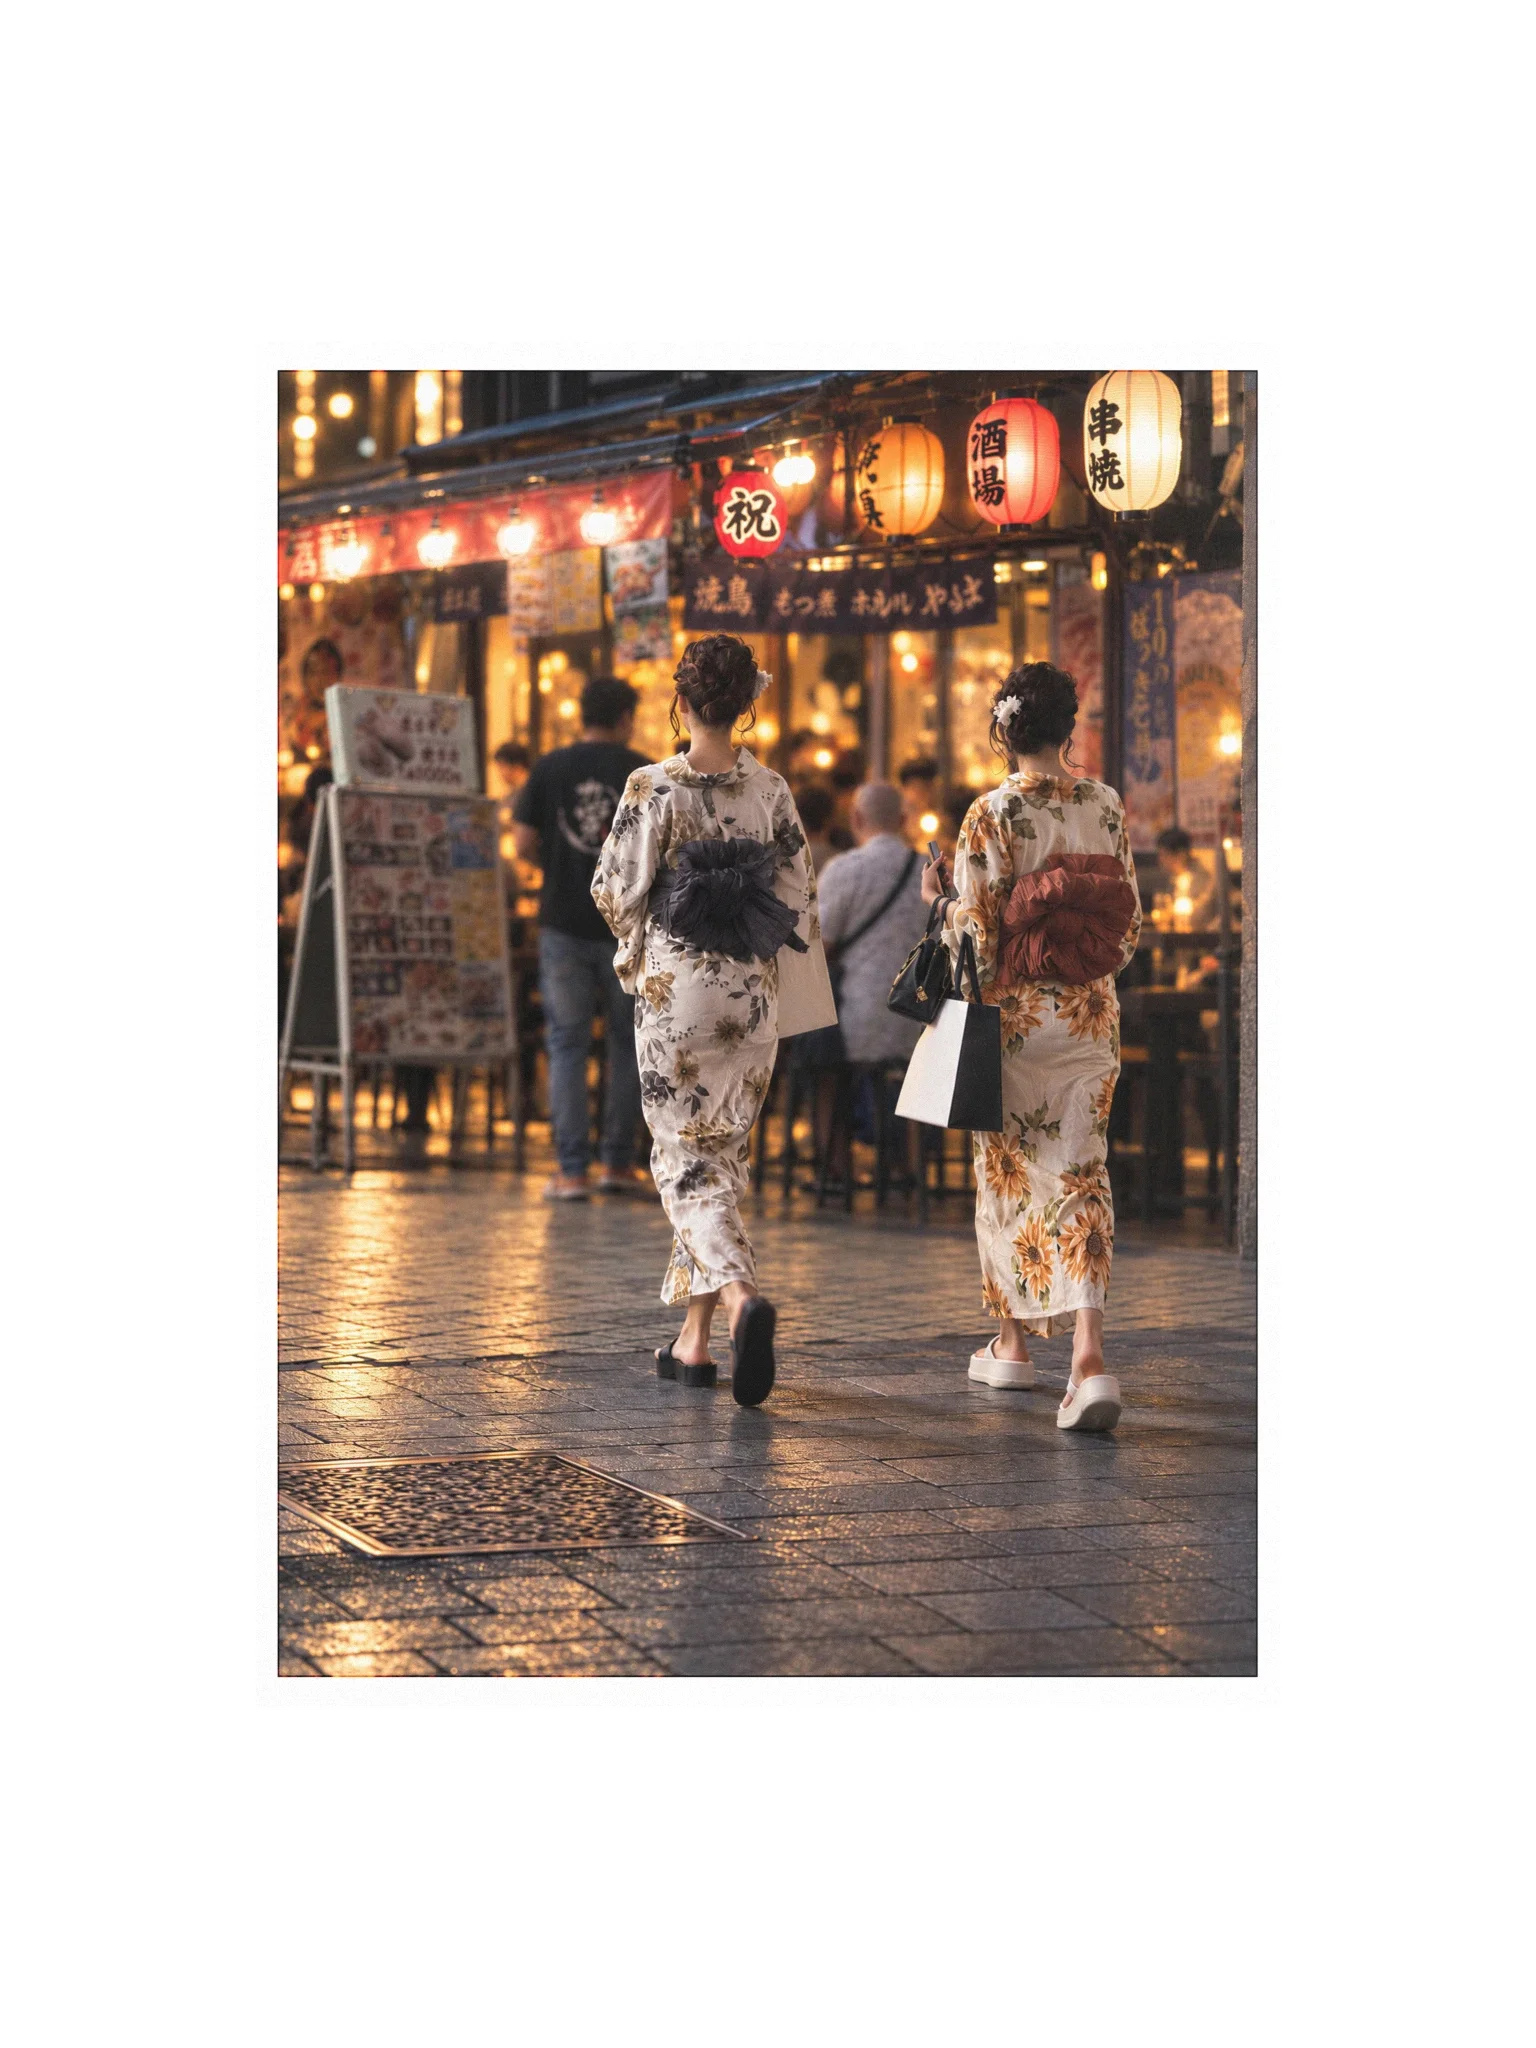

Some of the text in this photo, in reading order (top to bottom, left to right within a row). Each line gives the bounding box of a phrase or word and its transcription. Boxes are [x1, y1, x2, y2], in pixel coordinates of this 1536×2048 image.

[971, 418, 1007, 506] 酒場
[1088, 398, 1125, 492] 串焼
[723, 488, 779, 543] 祝
[693, 575, 756, 617] 焼鳥
